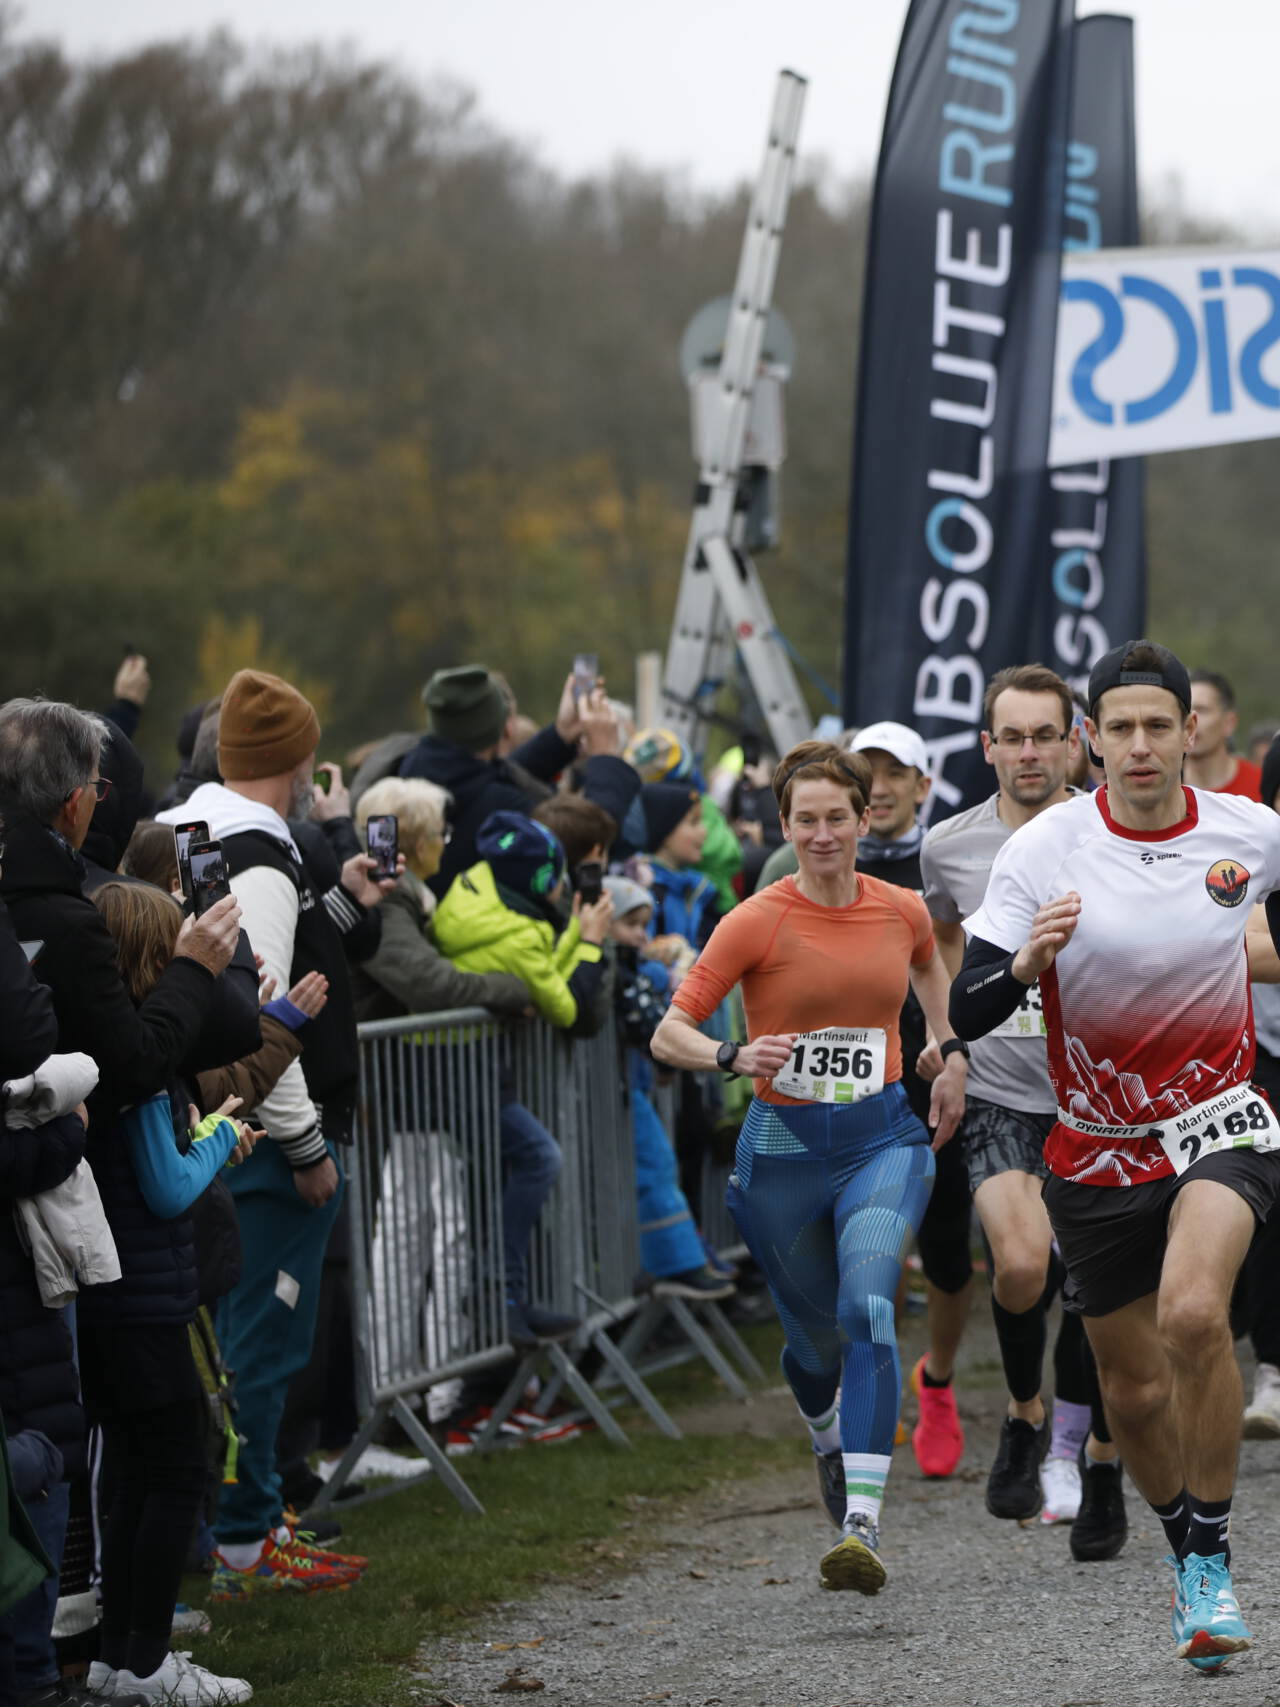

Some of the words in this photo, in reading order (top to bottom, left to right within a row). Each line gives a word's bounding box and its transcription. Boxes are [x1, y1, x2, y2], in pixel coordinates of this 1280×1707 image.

[798, 1030, 869, 1043] Martinslauf
[792, 1044, 873, 1080] 1356
[1075, 1121, 1139, 1136] DYNAFIT
[1176, 1088, 1250, 1134] Martinslauf
[1179, 1100, 1270, 1166] 2168
